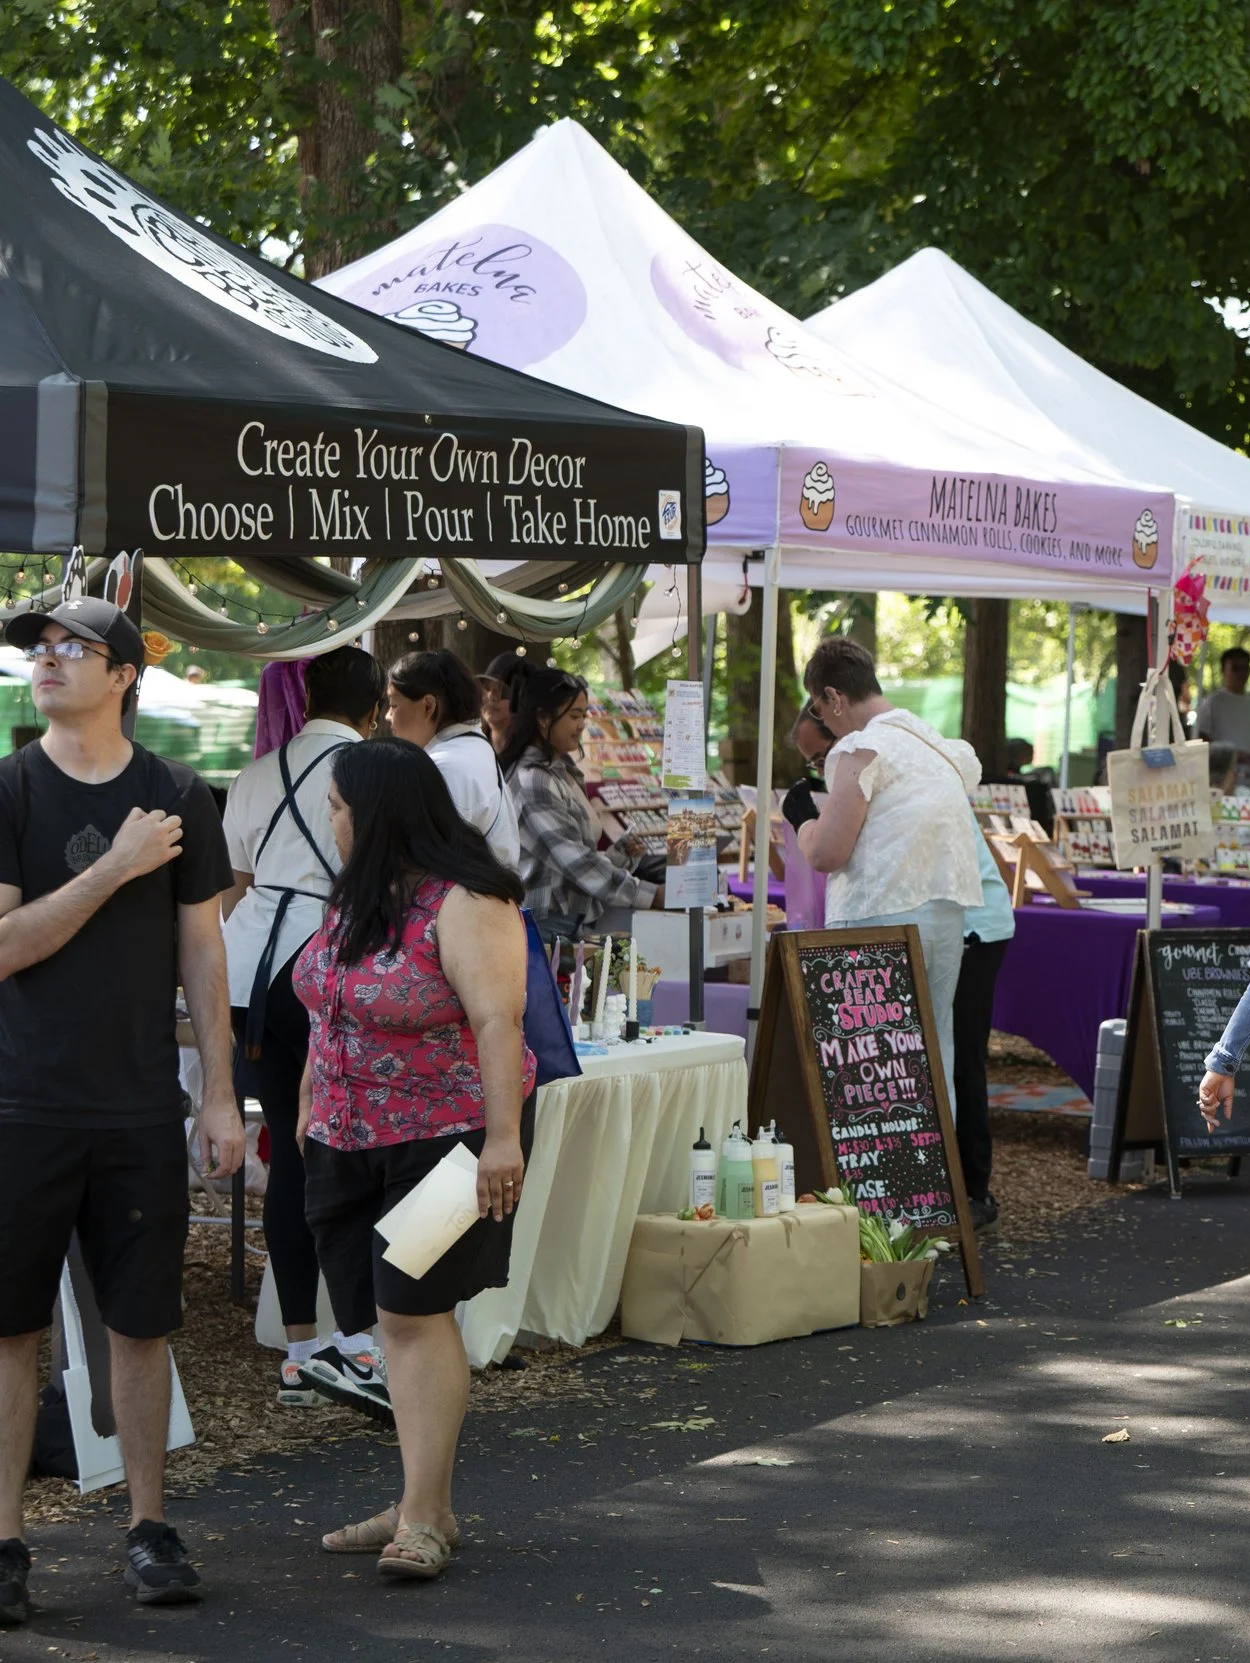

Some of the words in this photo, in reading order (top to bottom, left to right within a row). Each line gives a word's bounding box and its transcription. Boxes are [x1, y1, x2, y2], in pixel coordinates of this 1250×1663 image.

[413, 281, 483, 297] BAKES
[237, 421, 341, 478] Create
[354, 427, 423, 480] Your
[429, 432, 500, 484] Own
[507, 438, 586, 488] Decor
[148, 483, 274, 541] Choose
[308, 488, 372, 541] Mix
[403, 490, 474, 542] Pour
[503, 494, 567, 545] Take
[573, 498, 651, 549] Home
[929, 475, 1007, 526] MATELNA
[1013, 485, 1058, 533] BAKES
[845, 514, 904, 541] GOURMET
[908, 520, 978, 546] CINNAMON
[983, 526, 1017, 554] ROLLS,
[1020, 532, 1067, 560] COOKIES,
[1069, 540, 1091, 562] AND
[1095, 544, 1123, 567] MORE
[1128, 780, 1197, 805] SALAMAT
[1128, 800, 1196, 824] SALAMAT
[1131, 820, 1198, 844] SALAMAT
[820, 966, 893, 994] CRAFTY
[1182, 967, 1203, 981] UBE
[1204, 966, 1250, 981] BROWNIES
[843, 983, 887, 1006] BEAR
[838, 1001, 903, 1030] STUDIO
[820, 1033, 880, 1068] MAKE
[883, 1030, 925, 1055] YOUR
[860, 1057, 907, 1084] OWN
[831, 1122, 879, 1140] CANDLE
